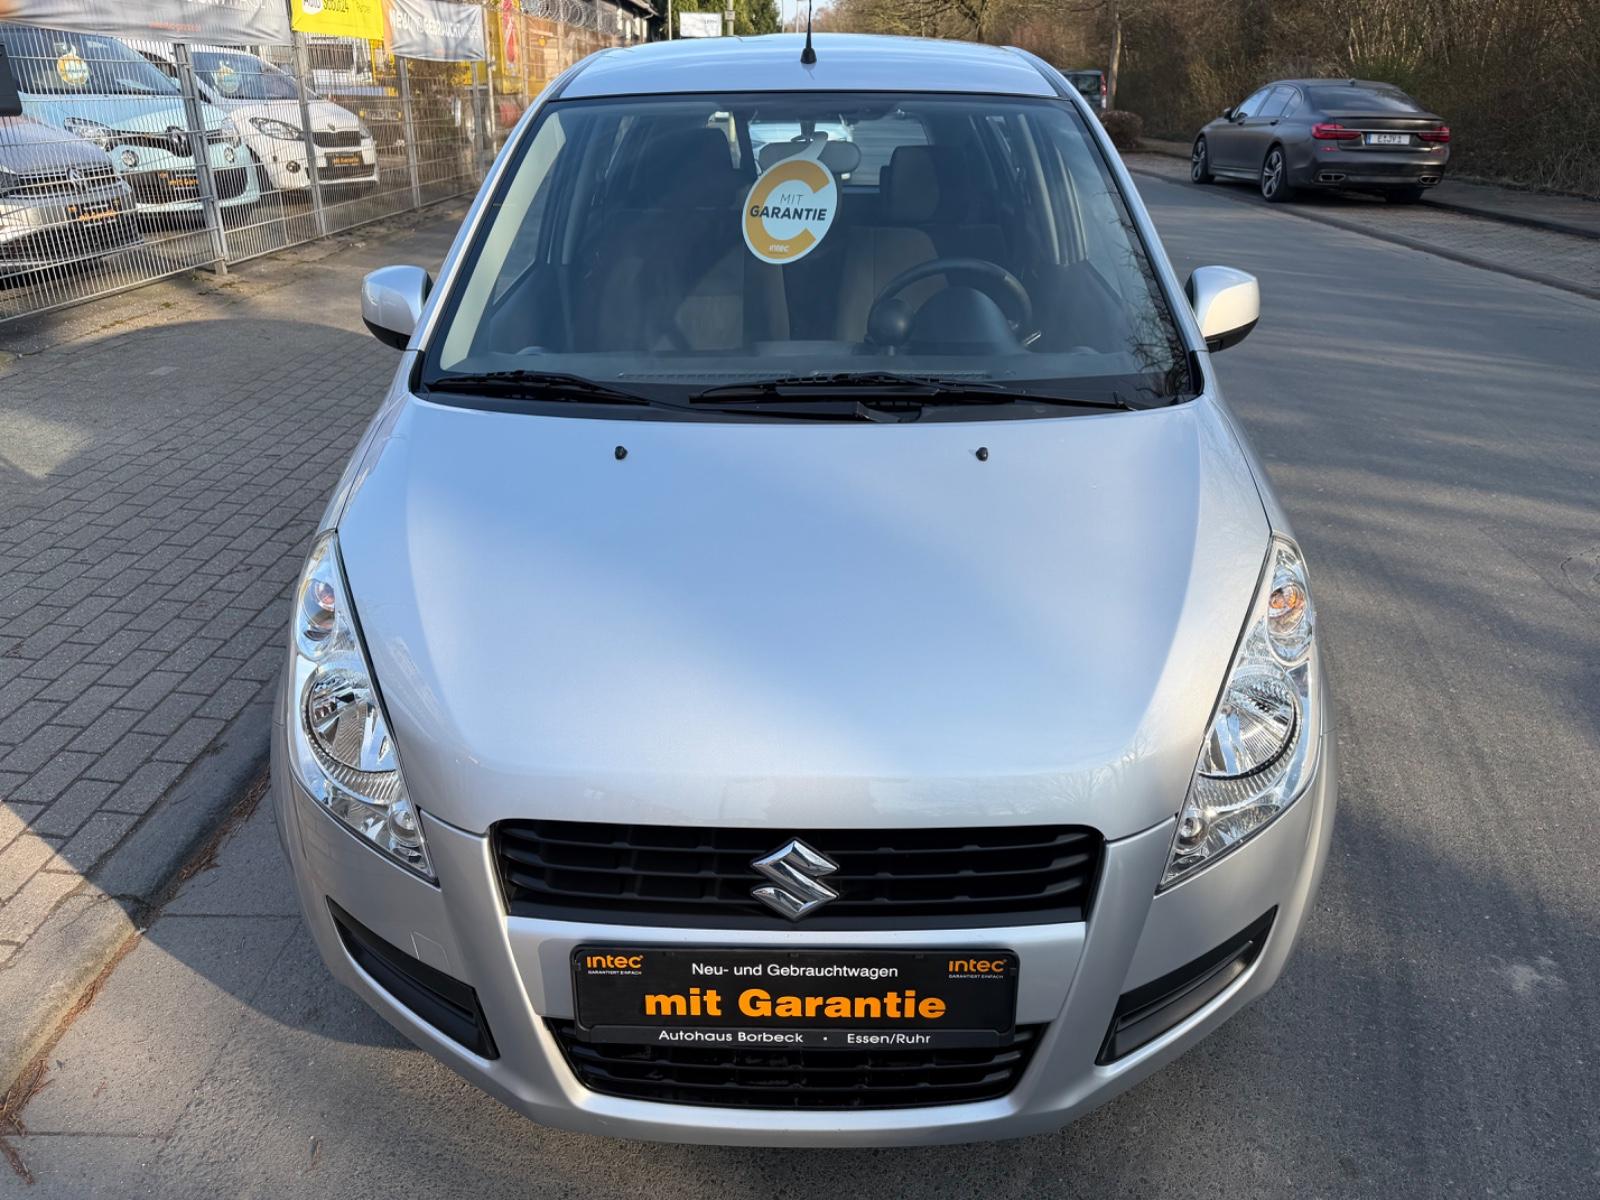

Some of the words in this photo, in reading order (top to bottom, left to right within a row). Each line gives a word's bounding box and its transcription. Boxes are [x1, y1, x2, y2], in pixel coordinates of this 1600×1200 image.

[780, 193, 805, 205] MIT
[750, 205, 827, 221] GARANTIE
[586, 954, 643, 969] intec
[949, 958, 1005, 973] intec
[692, 963, 729, 976] Neu-
[734, 964, 762, 976] und
[767, 964, 898, 980] Gebrauchtwagen
[644, 987, 722, 1017] mit
[738, 988, 947, 1020] Garantie
[658, 1030, 733, 1042] Autohaus
[738, 1032, 804, 1043] Borbeck
[847, 1033, 931, 1045] Essen/Ruhr
